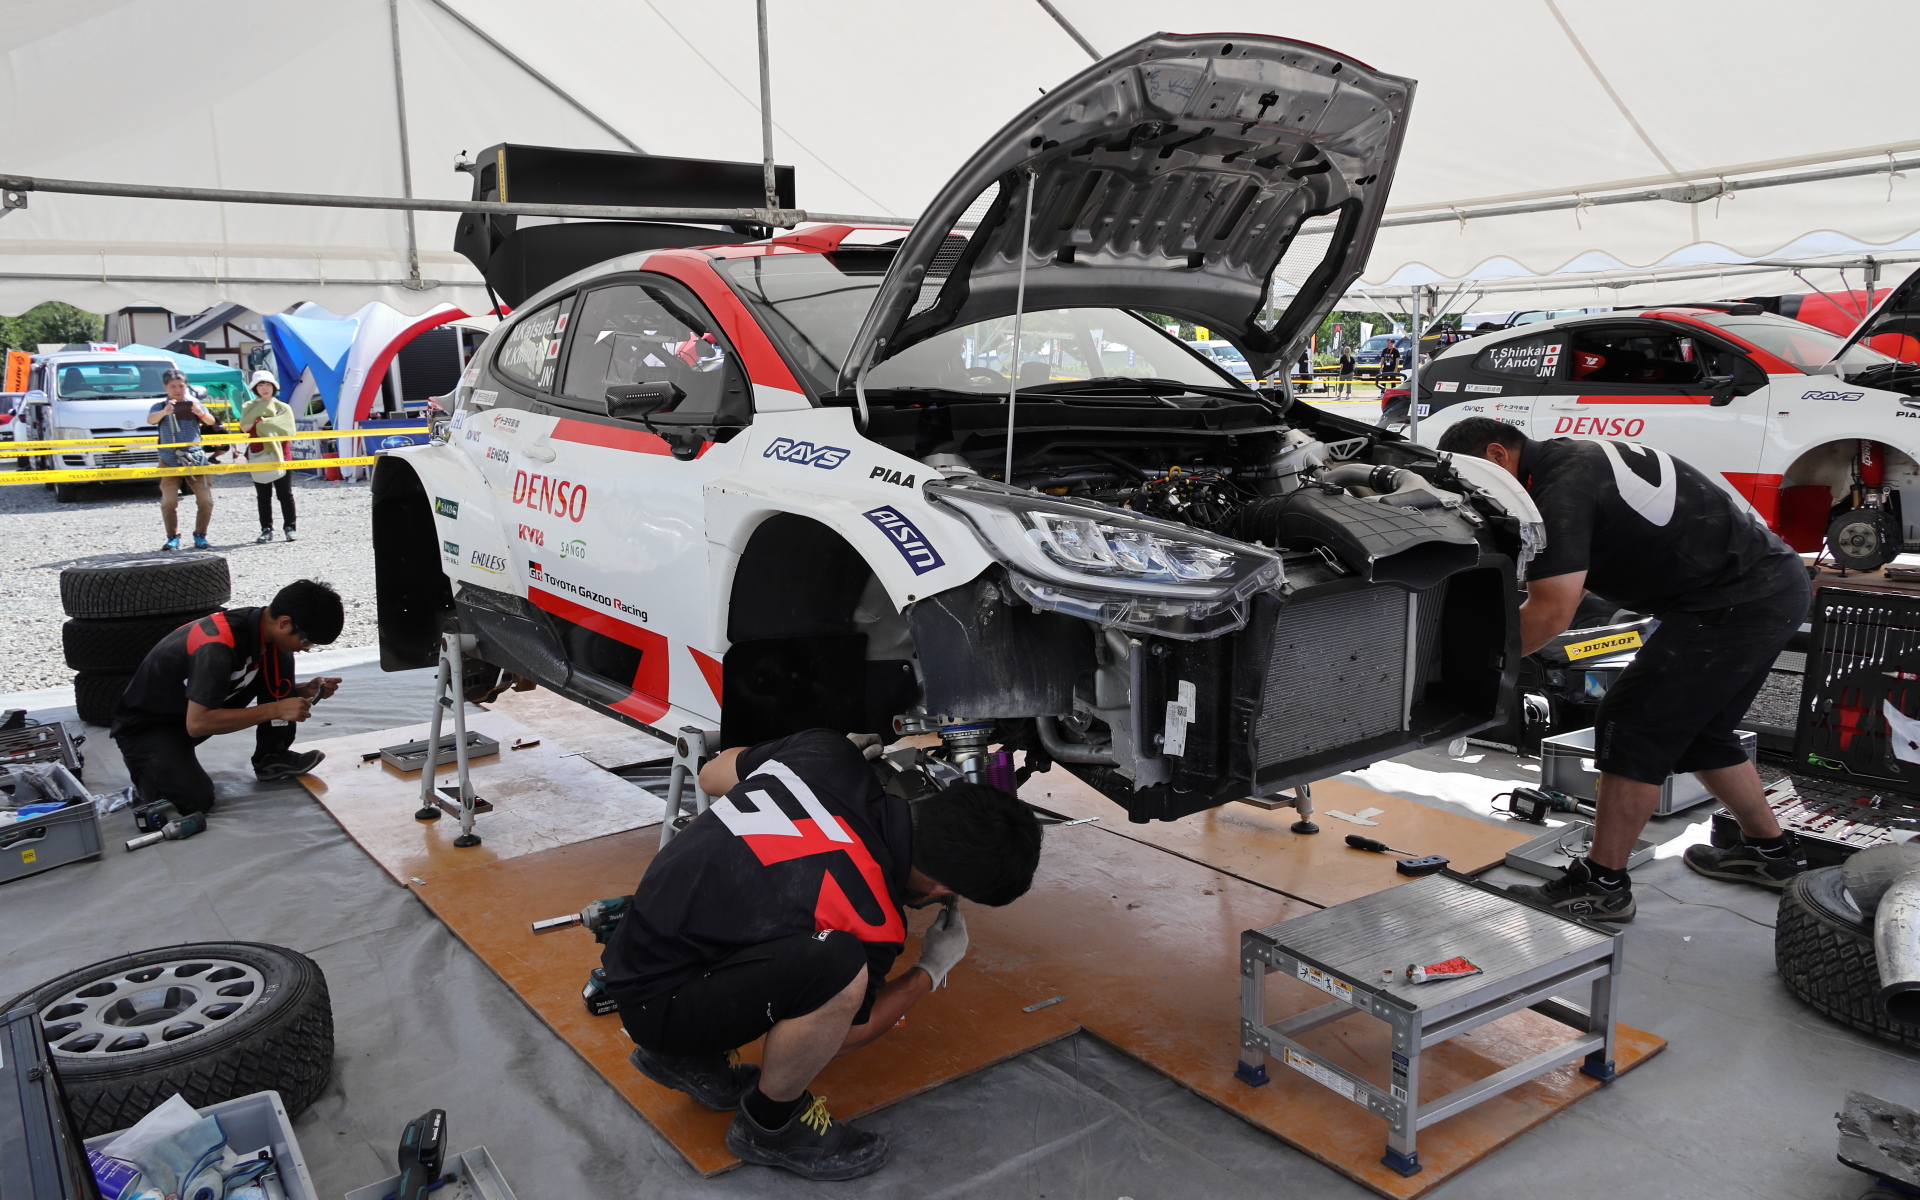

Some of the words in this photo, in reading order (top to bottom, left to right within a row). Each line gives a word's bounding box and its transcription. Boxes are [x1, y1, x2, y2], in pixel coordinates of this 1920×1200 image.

[1489, 345, 1546, 359] T.Shinkai
[1494, 357, 1538, 369] Y.Ando
[1536, 365, 1557, 378] JN1
[1801, 391, 1865, 402] RAYS
[450, 412, 466, 430] IHI
[1554, 416, 1645, 437] DENSO
[490, 448, 510, 463] ENEOS
[763, 437, 851, 470] RAYS
[869, 466, 916, 489] PIAA
[512, 469, 588, 523] DENSO
[518, 523, 545, 547] KYB
[869, 510, 937, 569] AISIN
[560, 541, 586, 559] SANGO
[470, 550, 507, 572] ENDLESS
[529, 567, 543, 582] GR
[544, 572, 577, 594] TOYOTA
[578, 586, 612, 607] GAZOO
[613, 598, 649, 623] Racing
[1582, 636, 1636, 653] DUNLOP
[23, 852, 34, 860] RR
